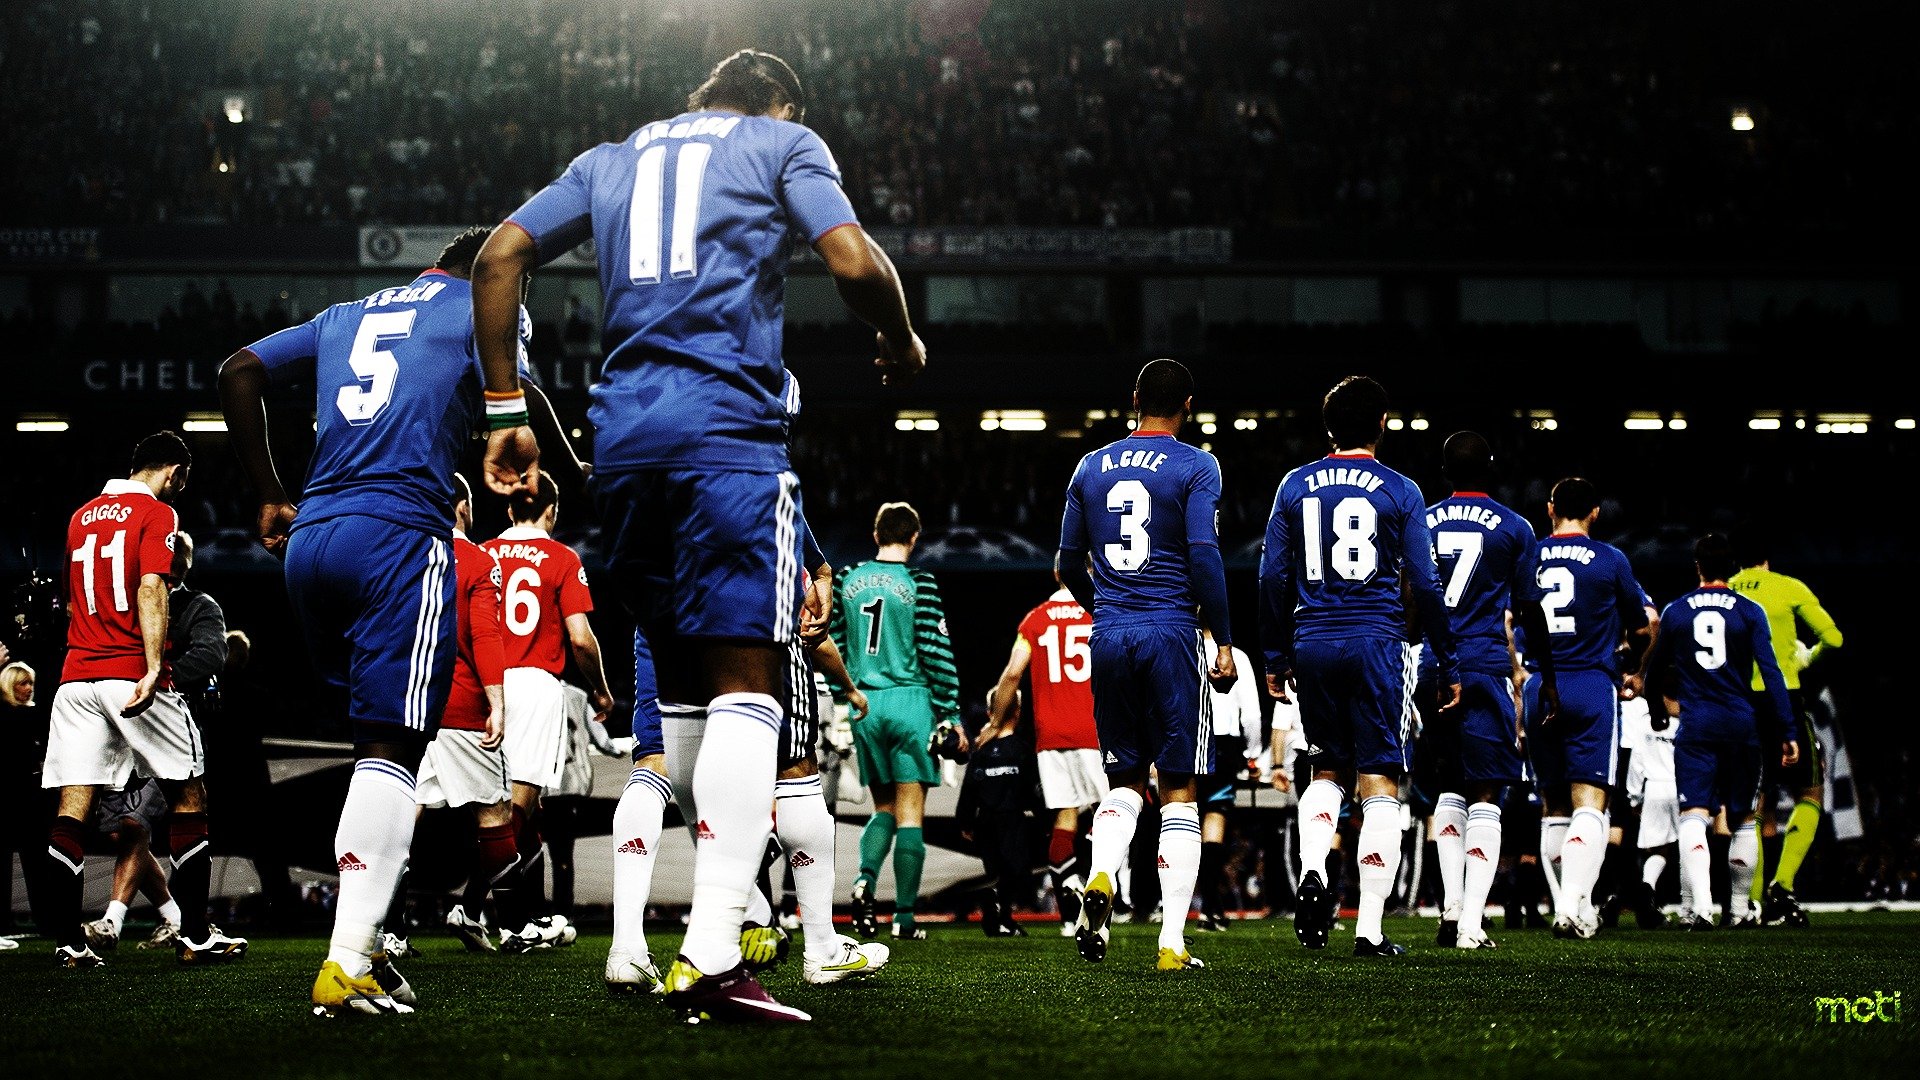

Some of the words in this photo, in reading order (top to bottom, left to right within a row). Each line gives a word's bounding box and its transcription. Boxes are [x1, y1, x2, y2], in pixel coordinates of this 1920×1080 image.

[629, 142, 712, 286] 11
[336, 308, 417, 427] 5
[1100, 449, 1168, 473] A.COLE
[1304, 467, 1386, 493] ZHIRKOV
[81, 502, 133, 526] GIGGS
[1104, 479, 1151, 576] 3
[1302, 496, 1378, 584] 18
[71, 529, 129, 616] 11
[505, 566, 542, 637] 6
[1437, 530, 1484, 611] 7
[1539, 566, 1577, 636] 2
[860, 598, 885, 657] 1
[1037, 623, 1093, 684] 15
[1693, 610, 1728, 671] 9
[617, 846, 648, 856] adidas
